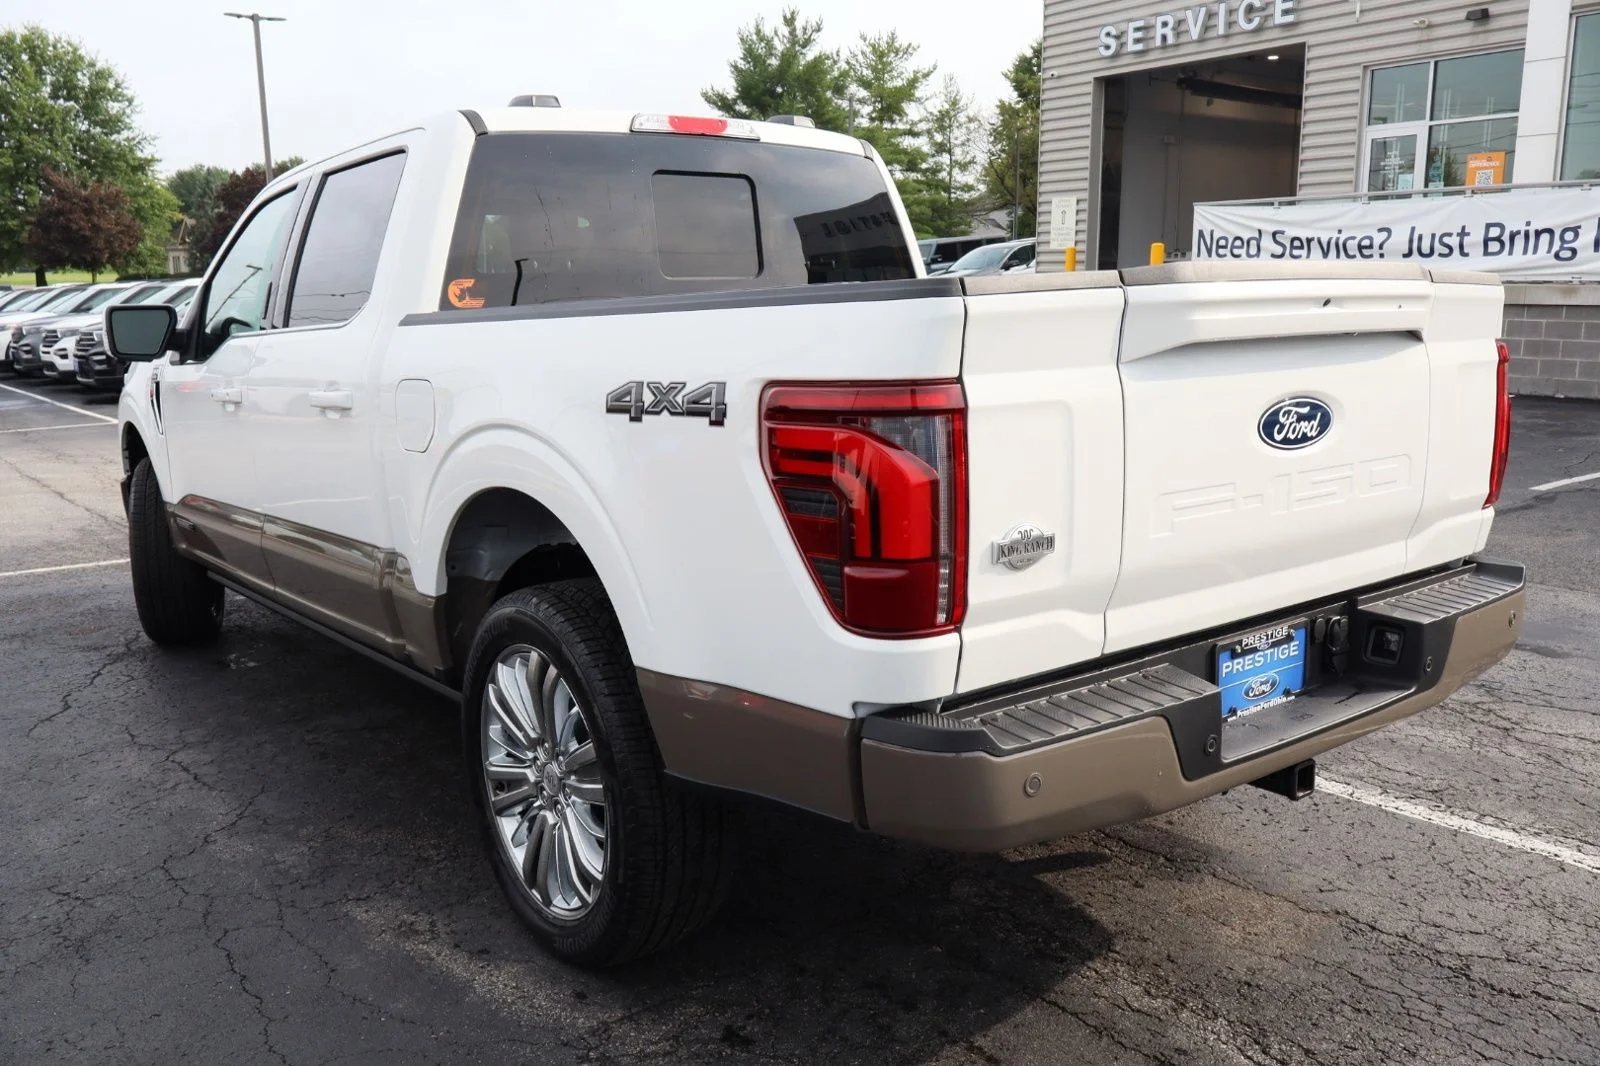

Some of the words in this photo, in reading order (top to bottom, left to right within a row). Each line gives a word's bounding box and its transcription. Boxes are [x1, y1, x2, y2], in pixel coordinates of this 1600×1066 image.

[1099, 0, 1296, 56] SERVICE
[1197, 229, 1263, 258] Need
[1270, 227, 1393, 259] Service?
[1402, 225, 1471, 258] Just
[1482, 221, 1582, 262] Bring
[1273, 405, 1321, 440] Ford
[1150, 453, 1413, 538] F-150
[1000, 544, 1022, 558] KING
[1024, 536, 1053, 553] RANCH
[1242, 626, 1289, 647] PRESTIGE
[1222, 641, 1299, 677] PRESTIGE
